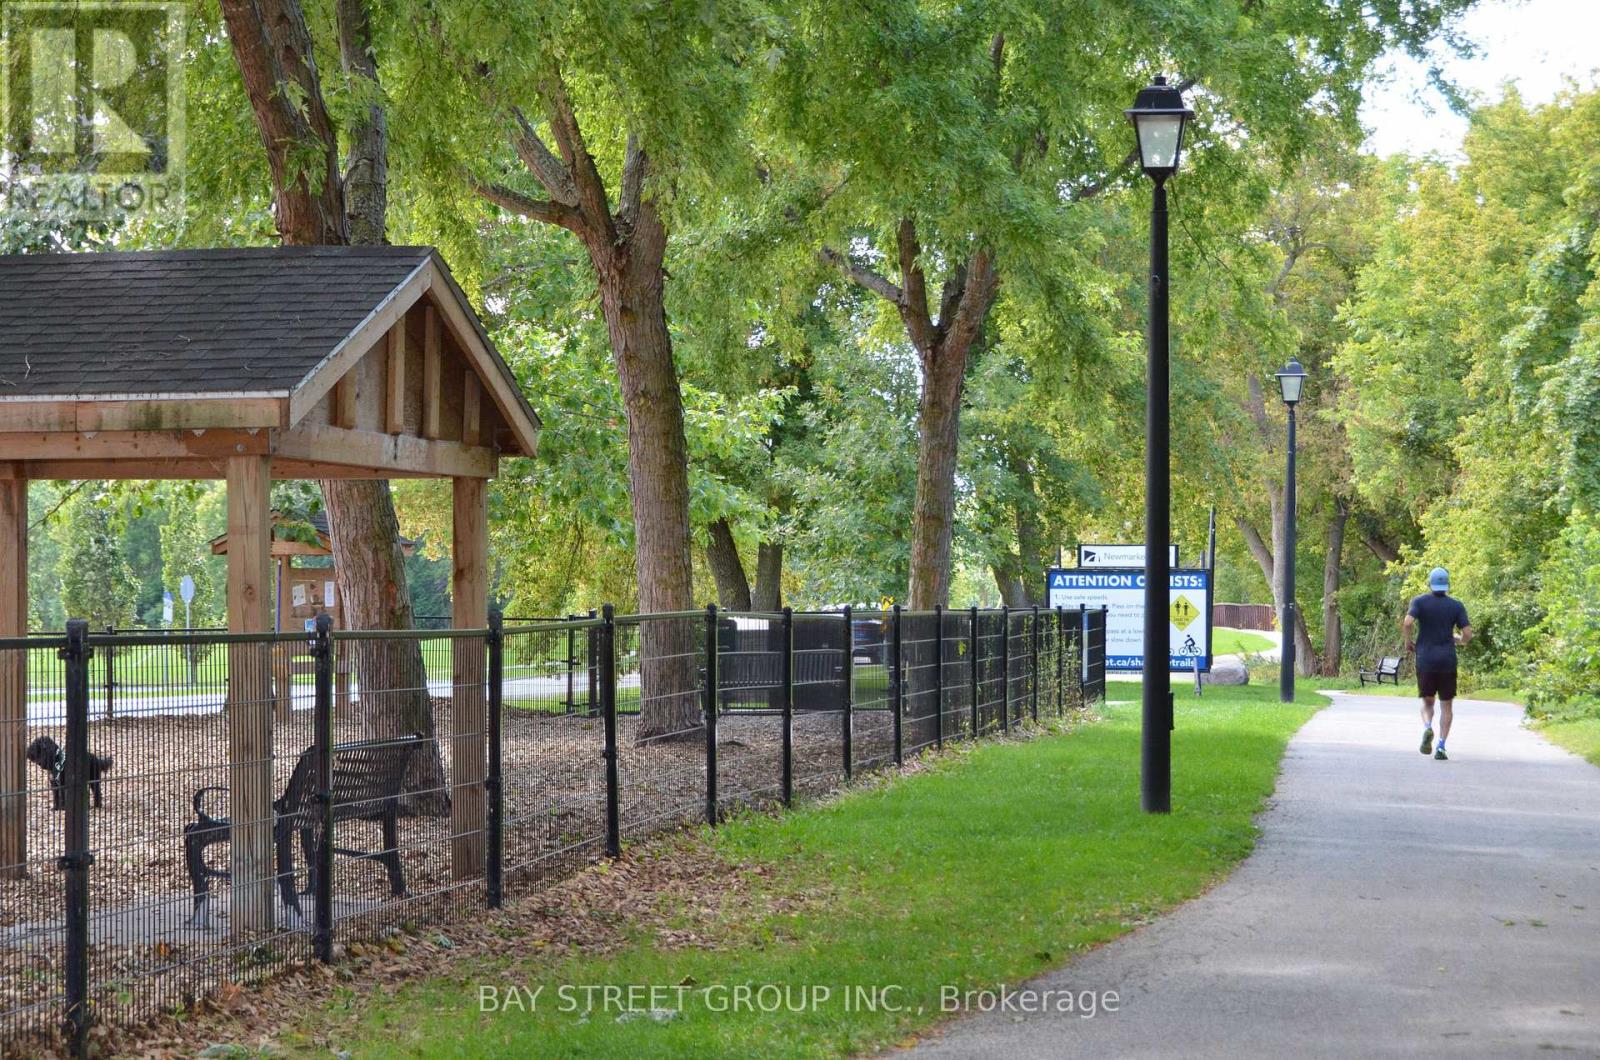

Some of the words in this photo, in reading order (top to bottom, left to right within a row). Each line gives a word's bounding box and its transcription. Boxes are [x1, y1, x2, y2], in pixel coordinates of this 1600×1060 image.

[1102, 551, 1145, 560] Newmarke
[1053, 574, 1132, 587] ATTENTION
[1135, 574, 1203, 587] CISTS:
